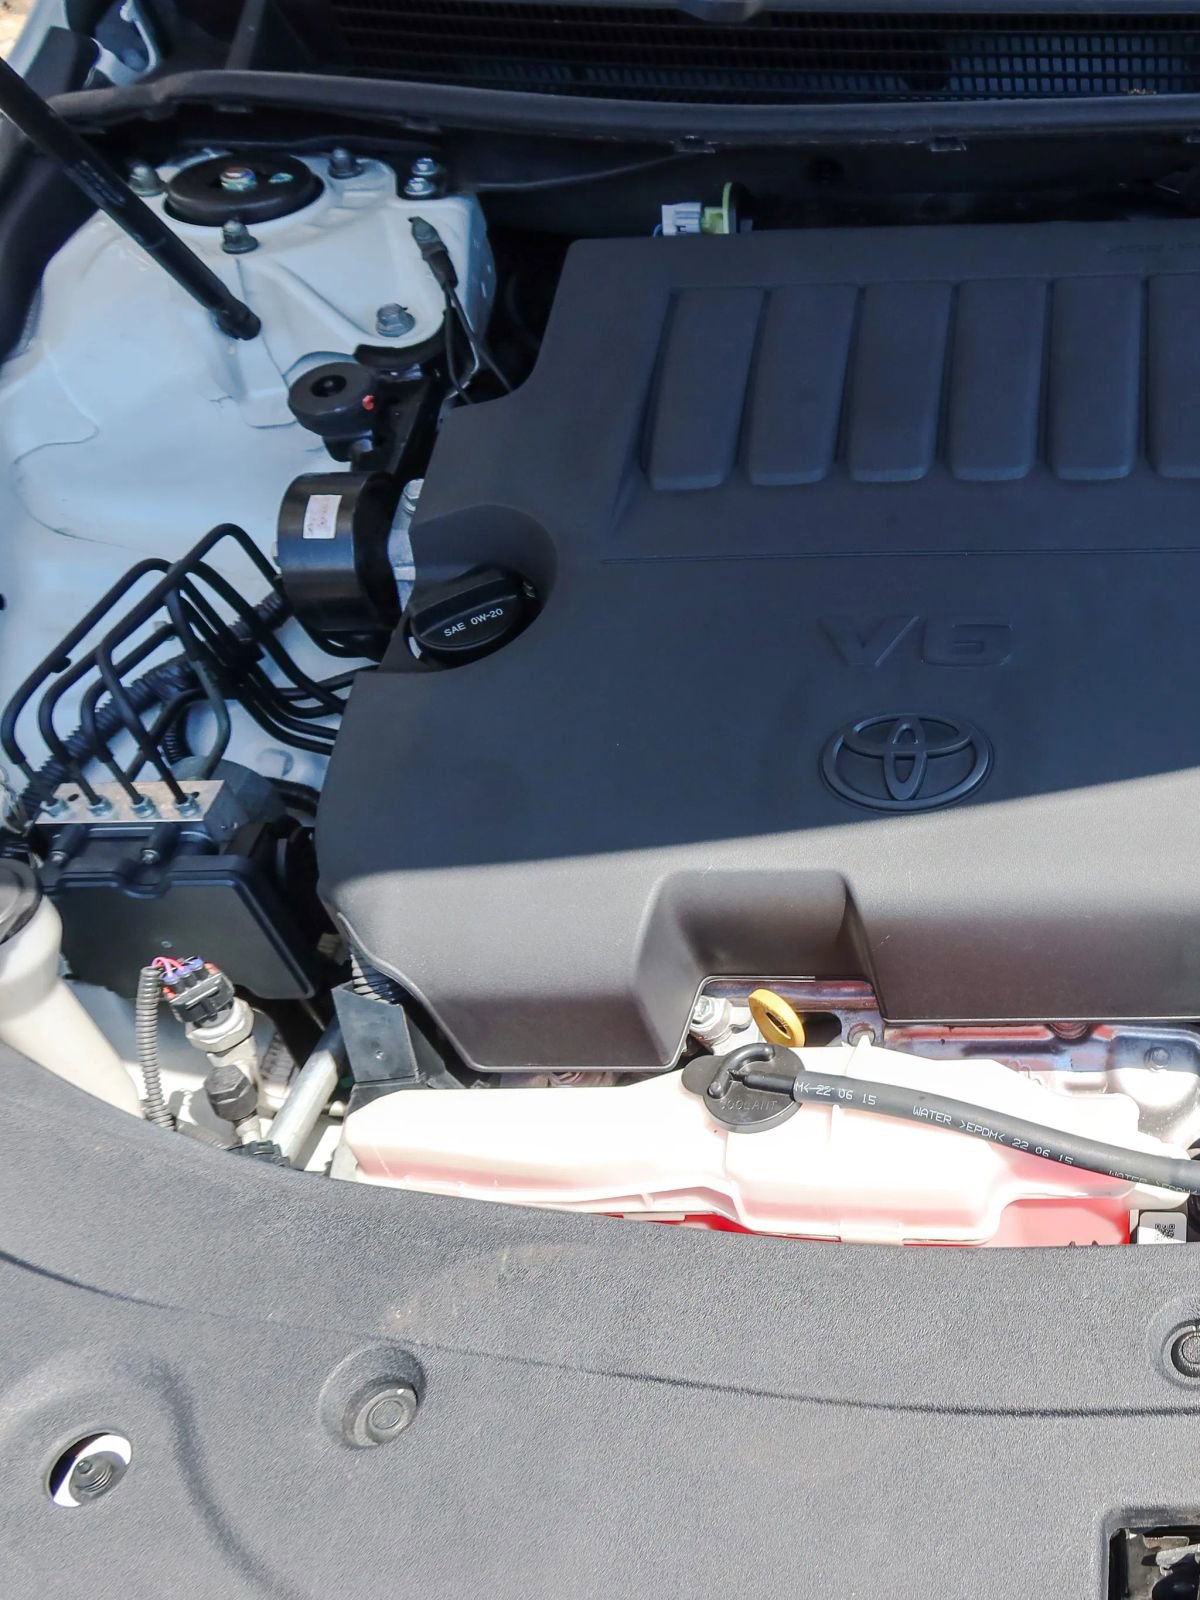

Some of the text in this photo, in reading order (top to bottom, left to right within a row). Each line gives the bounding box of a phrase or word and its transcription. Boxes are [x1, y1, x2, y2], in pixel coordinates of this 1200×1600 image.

[443, 608, 504, 637] SAE 0W-20
[815, 615, 1014, 669] V6
[718, 1099, 778, 1112] COOLANT
[838, 1088, 854, 1100] 06
[862, 1093, 877, 1105] 15
[912, 1105, 1074, 1166] WATER >EPDM< 22 06 15
